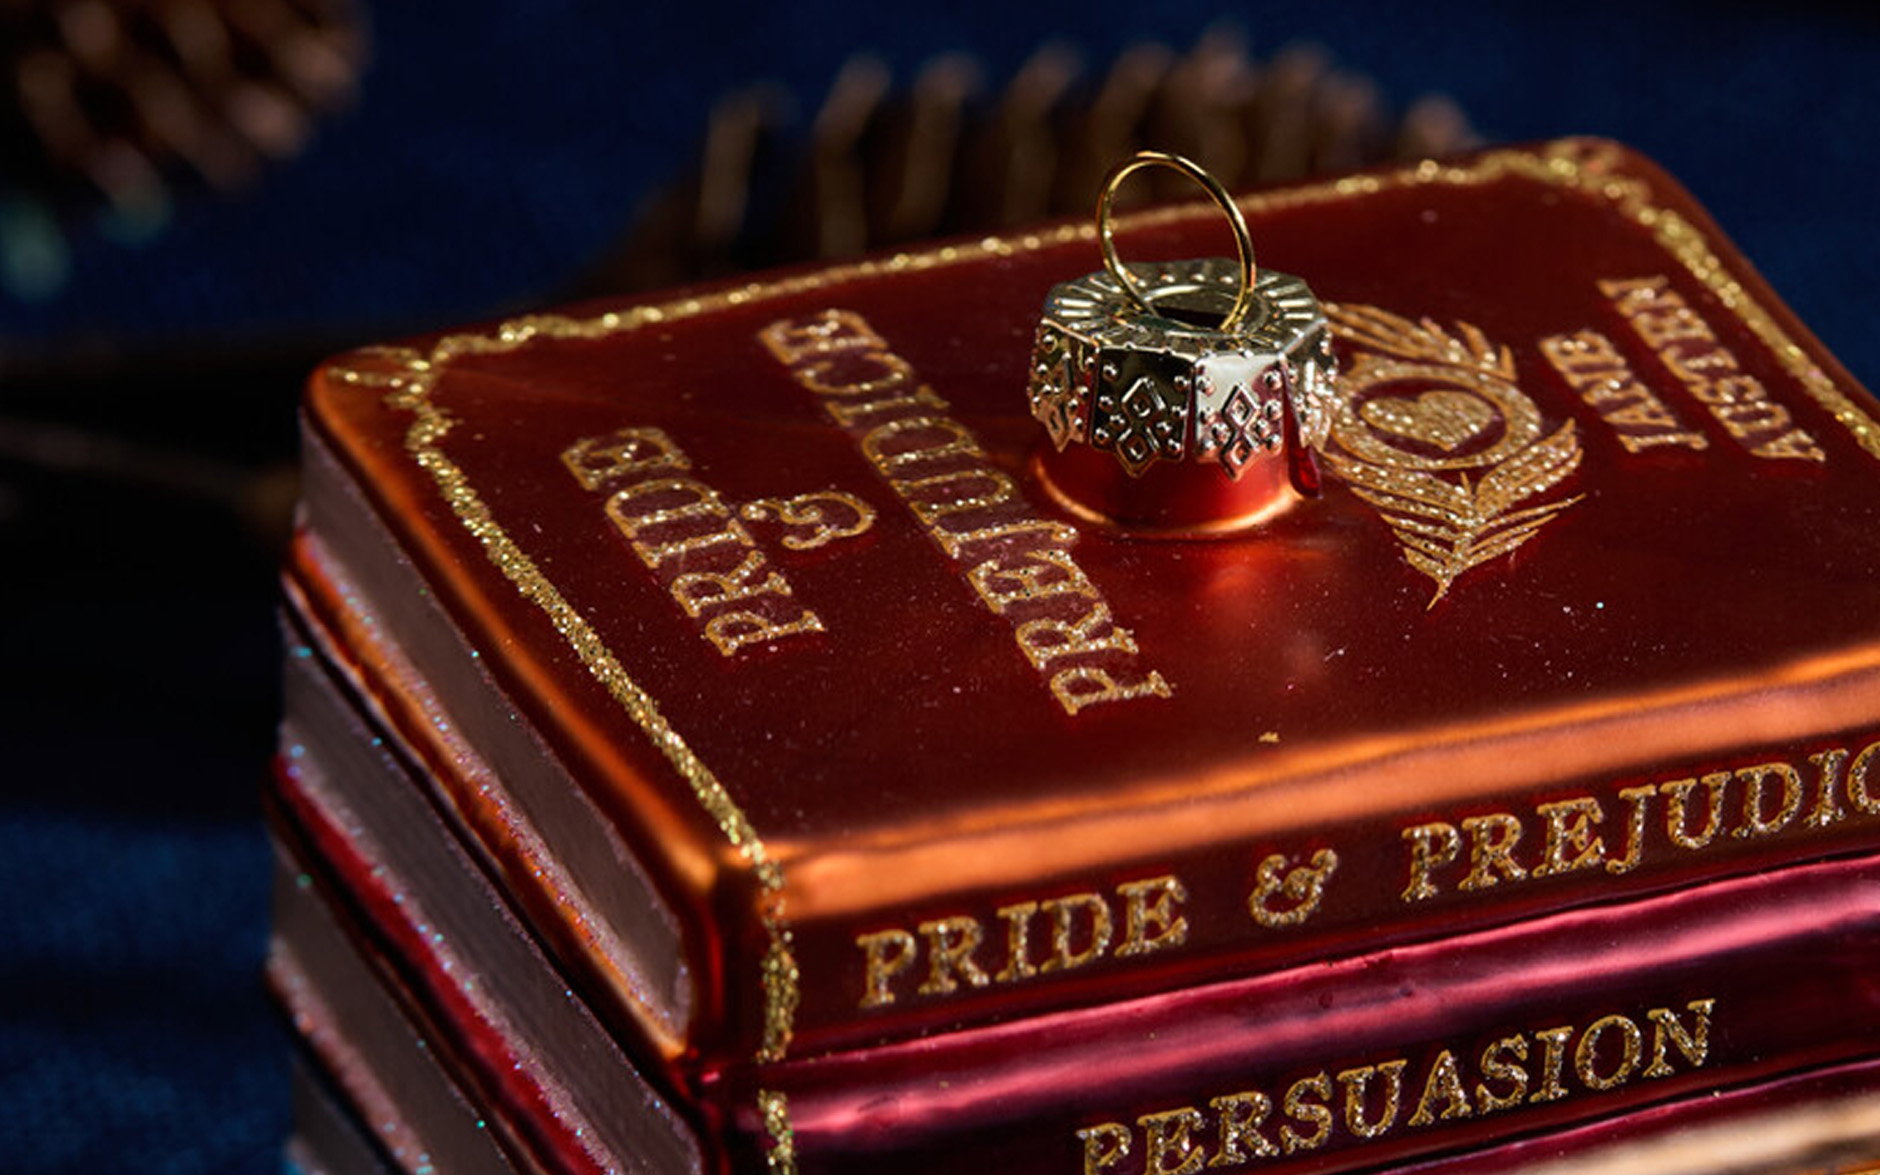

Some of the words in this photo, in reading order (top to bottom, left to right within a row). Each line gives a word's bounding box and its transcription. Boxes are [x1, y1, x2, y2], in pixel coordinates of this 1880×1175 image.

[1539, 329, 1709, 454] JANE
[1596, 274, 1826, 463] AUSTEN
[560, 426, 827, 657] PRIDE
[739, 491, 877, 551] &
[757, 308, 1174, 716] PREJUDICE
[856, 874, 1190, 1007] PRIDE
[1249, 848, 1339, 928] &
